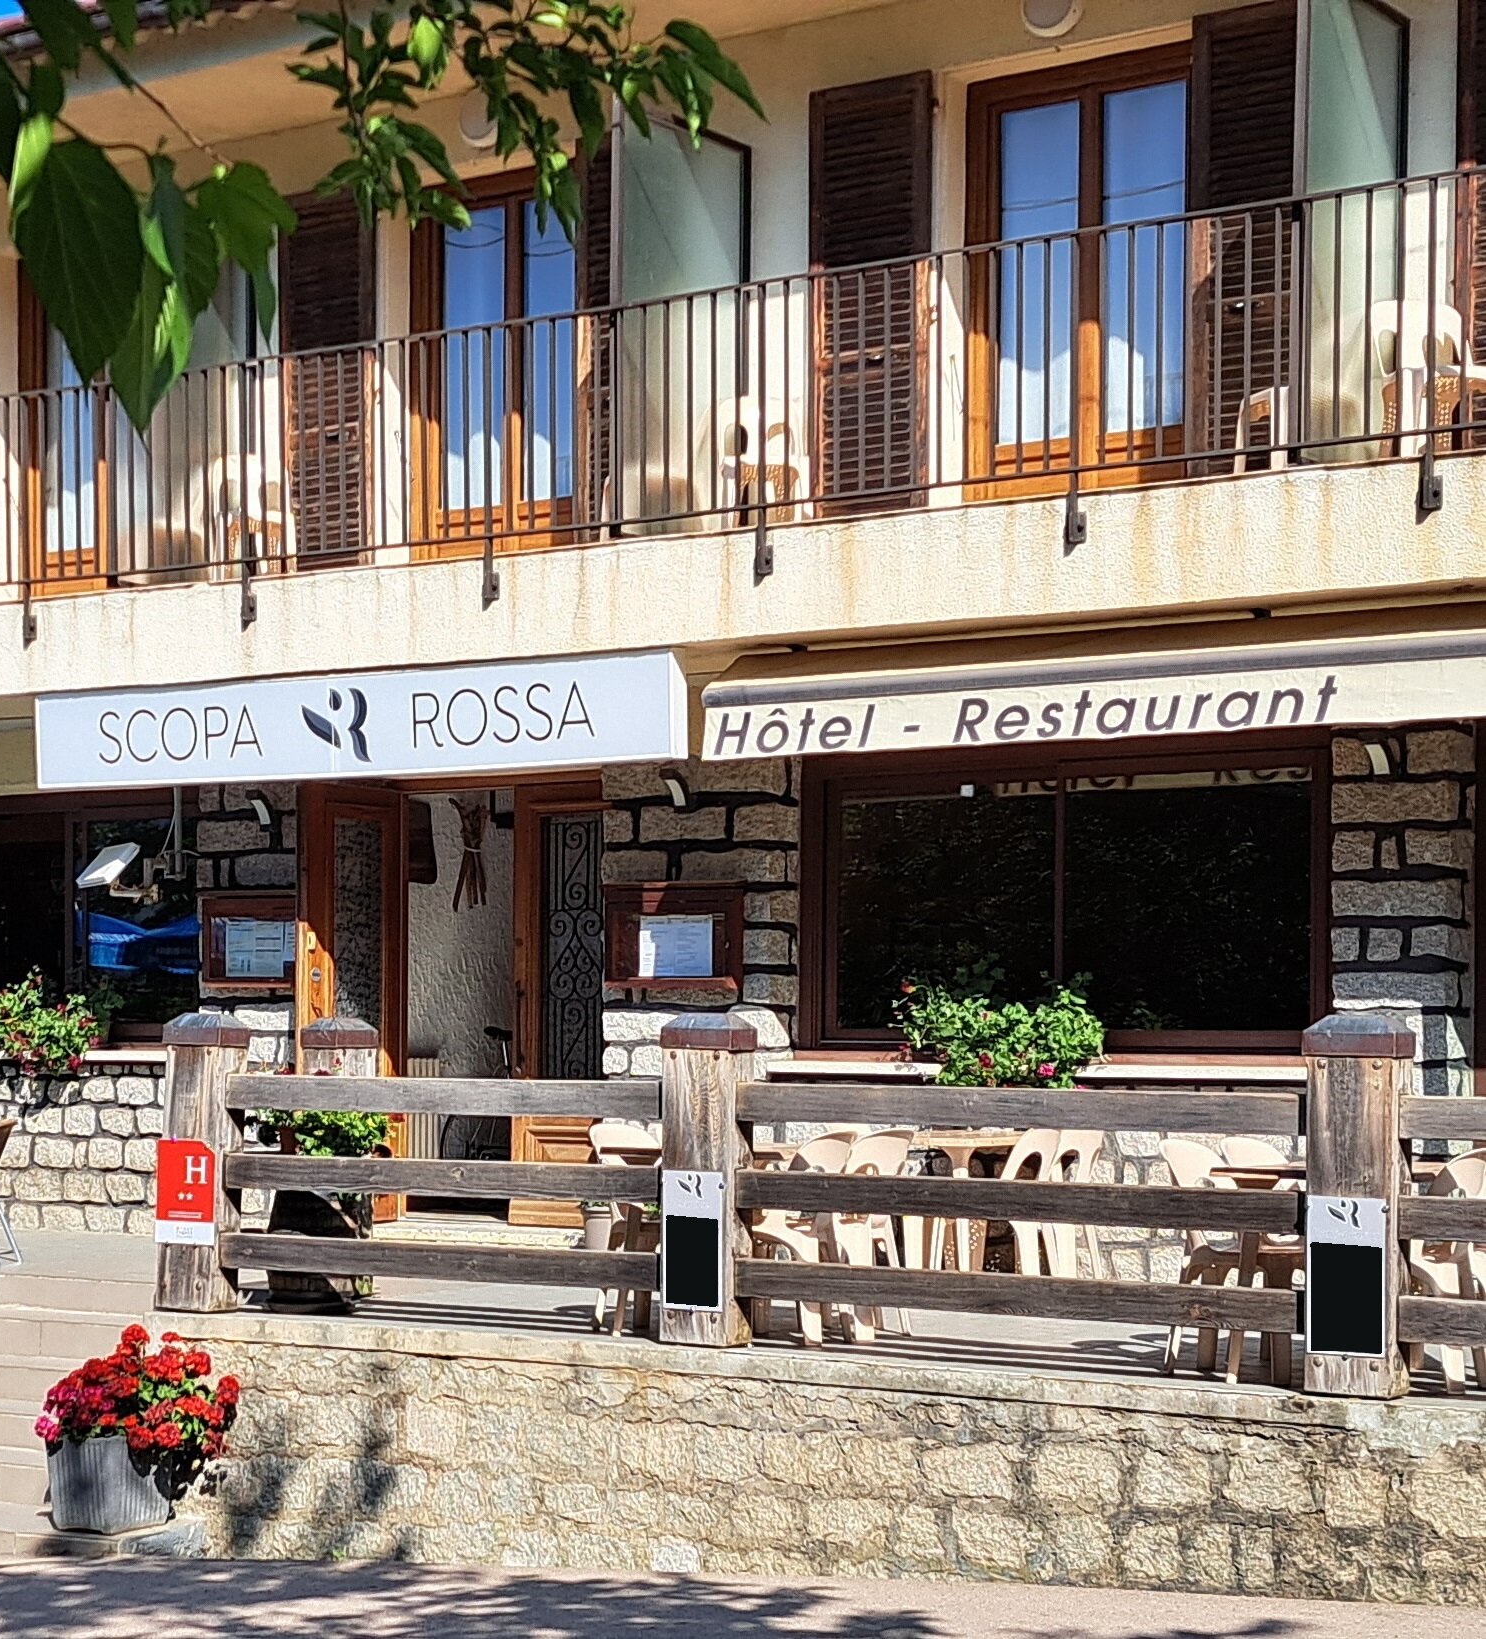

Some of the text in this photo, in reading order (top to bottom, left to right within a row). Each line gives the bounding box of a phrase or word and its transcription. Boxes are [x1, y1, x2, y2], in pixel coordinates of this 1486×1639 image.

[98, 681, 595, 763] SCOPA ROSSA
[713, 703, 876, 756] Hôtel
[952, 675, 1338, 743] Restaurant
[184, 1155, 209, 1185] H
